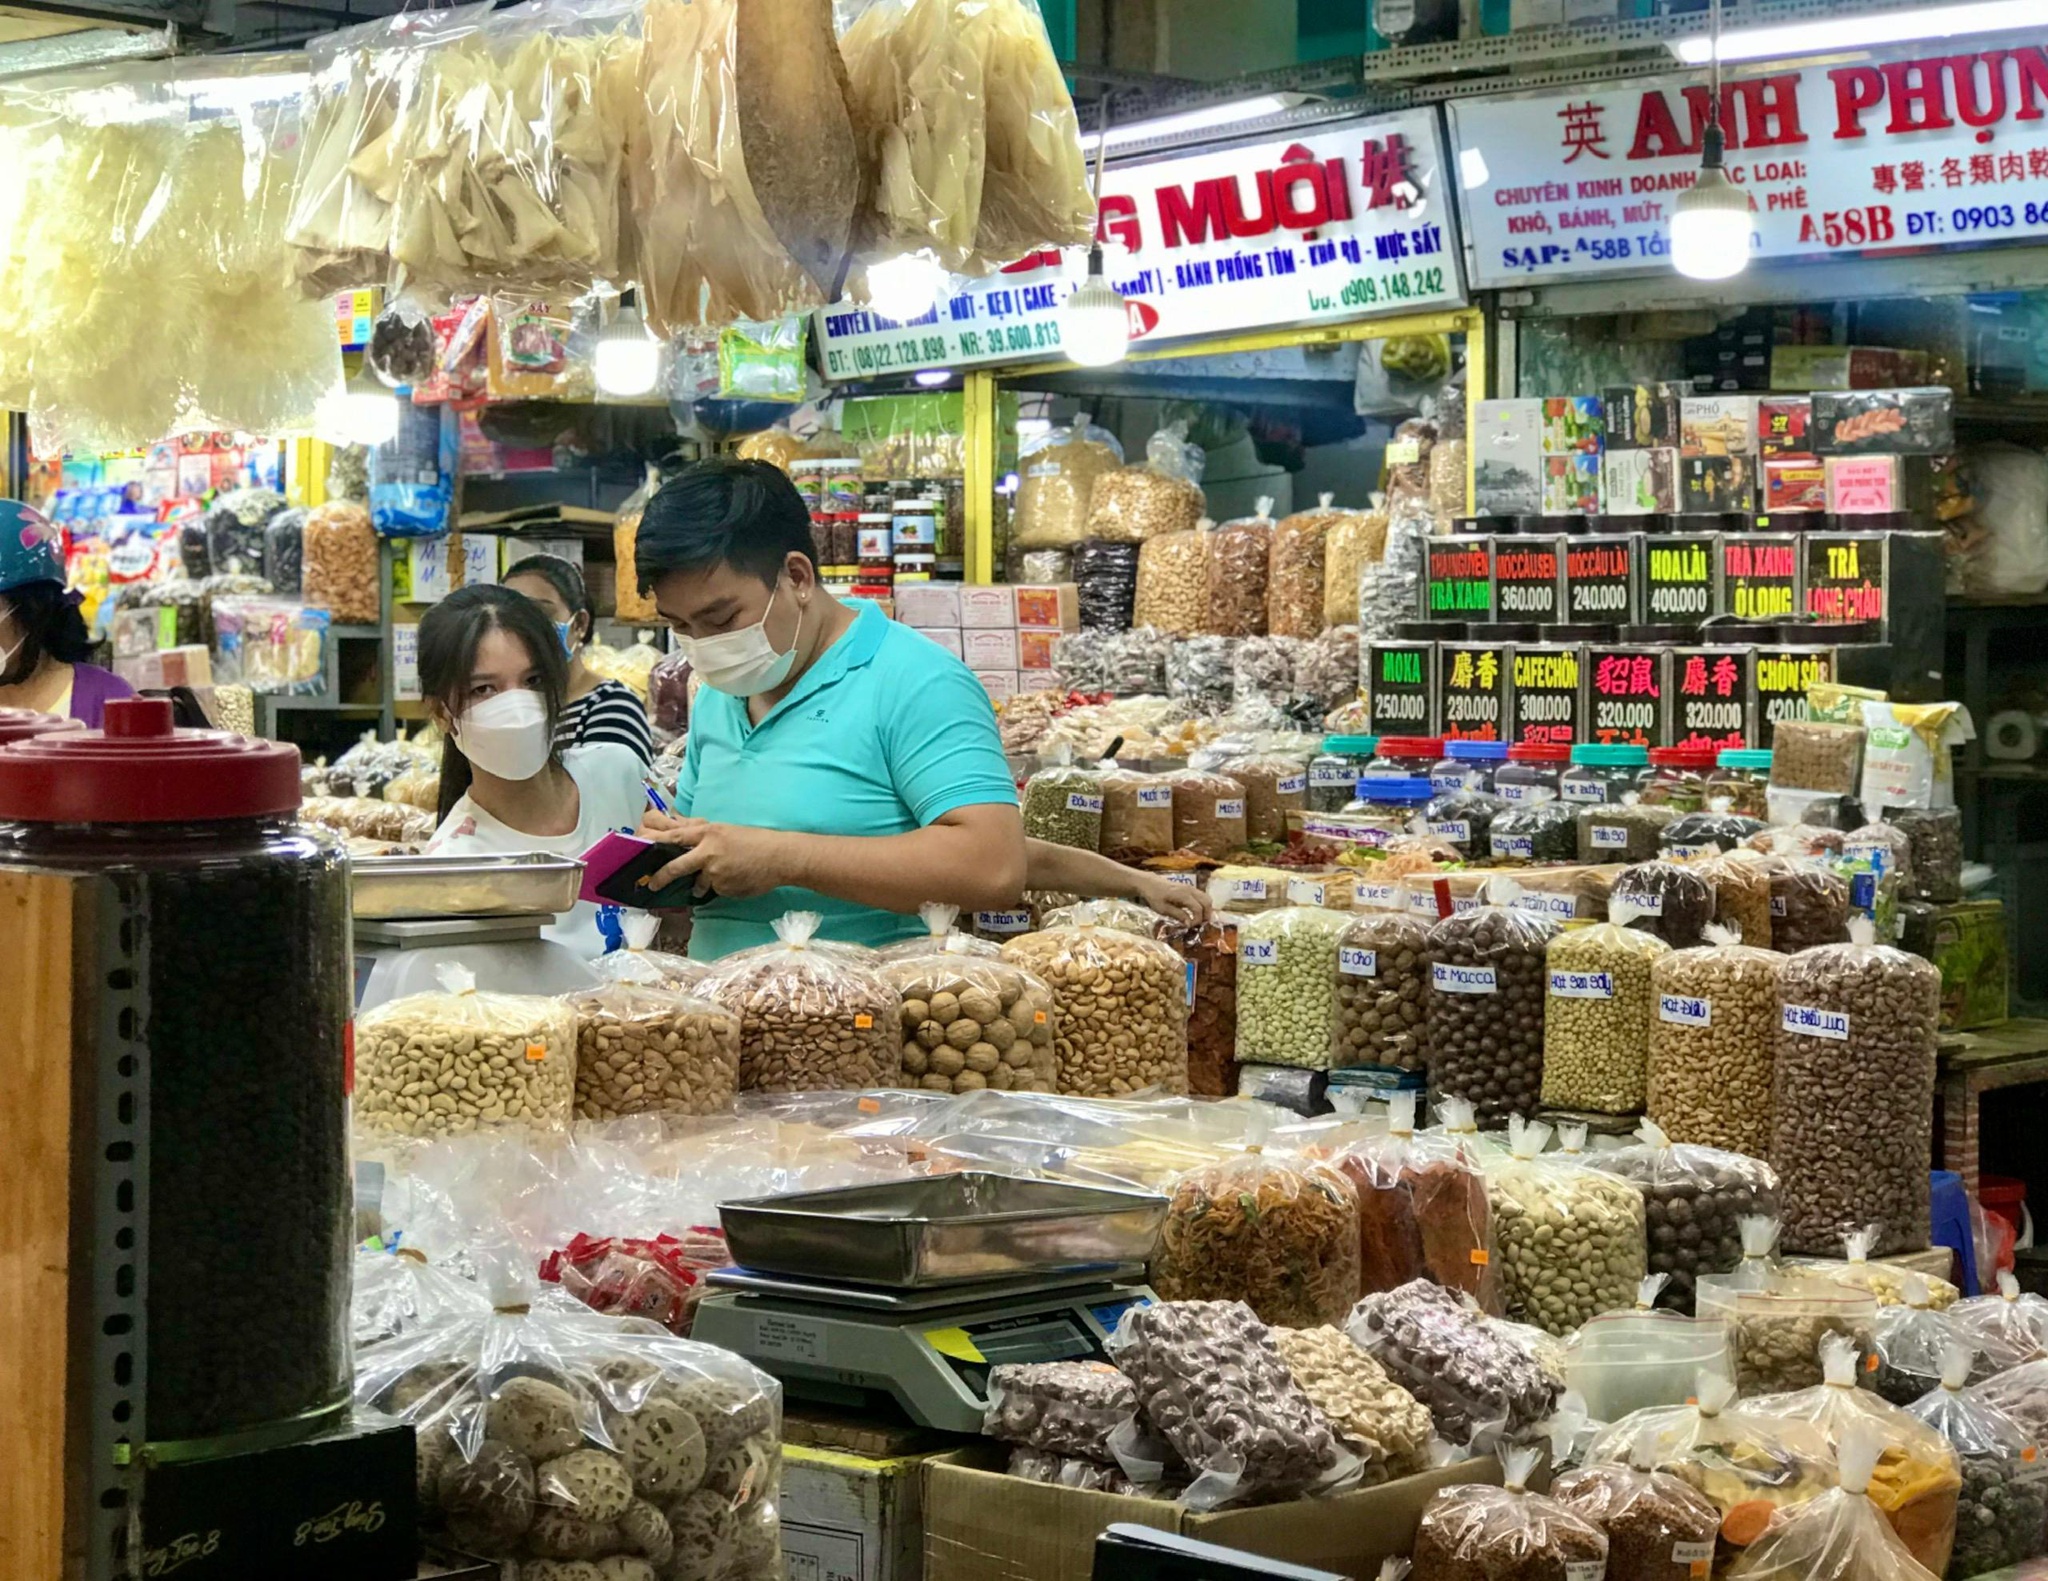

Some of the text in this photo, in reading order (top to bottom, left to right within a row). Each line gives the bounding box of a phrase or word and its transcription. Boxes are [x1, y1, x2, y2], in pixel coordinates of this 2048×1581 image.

[1626, 73, 1808, 160] ANH
[1558, 101, 1610, 164] 英
[1155, 142, 1352, 248] MUỘI
[1494, 181, 1569, 207] CHUYÊN
[1577, 175, 1622, 200] KINH
[1631, 170, 1697, 194] DOANH
[1767, 188, 1808, 211] PHÊ
[1798, 205, 1895, 247] A58B
[1906, 211, 1944, 236] ĐT:
[1952, 205, 2015, 231] 0903
[1025, 284, 1058, 312] CAKE
[1176, 261, 1213, 289] BÁNH
[1375, 229, 1409, 264] MỰC
[1413, 222, 1443, 254] SẤY
[1503, 244, 1570, 272] SẠP:
[959, 332, 985, 357] NR:
[987, 321, 1061, 352] 39.600.813
[1754, 546, 1794, 577] XANH
[1501, 586, 1552, 612] 360.000
[1574, 585, 1626, 610] 240.000
[1652, 587, 1707, 613] 400.000
[1383, 652, 1421, 684] MOKA
[1375, 693, 1425, 720] 250.000
[1447, 696, 1498, 722] 230.000
[1520, 695, 1571, 721] 300.000
[1597, 702, 1653, 728] 320.000
[1686, 702, 1741, 729] 320.000
